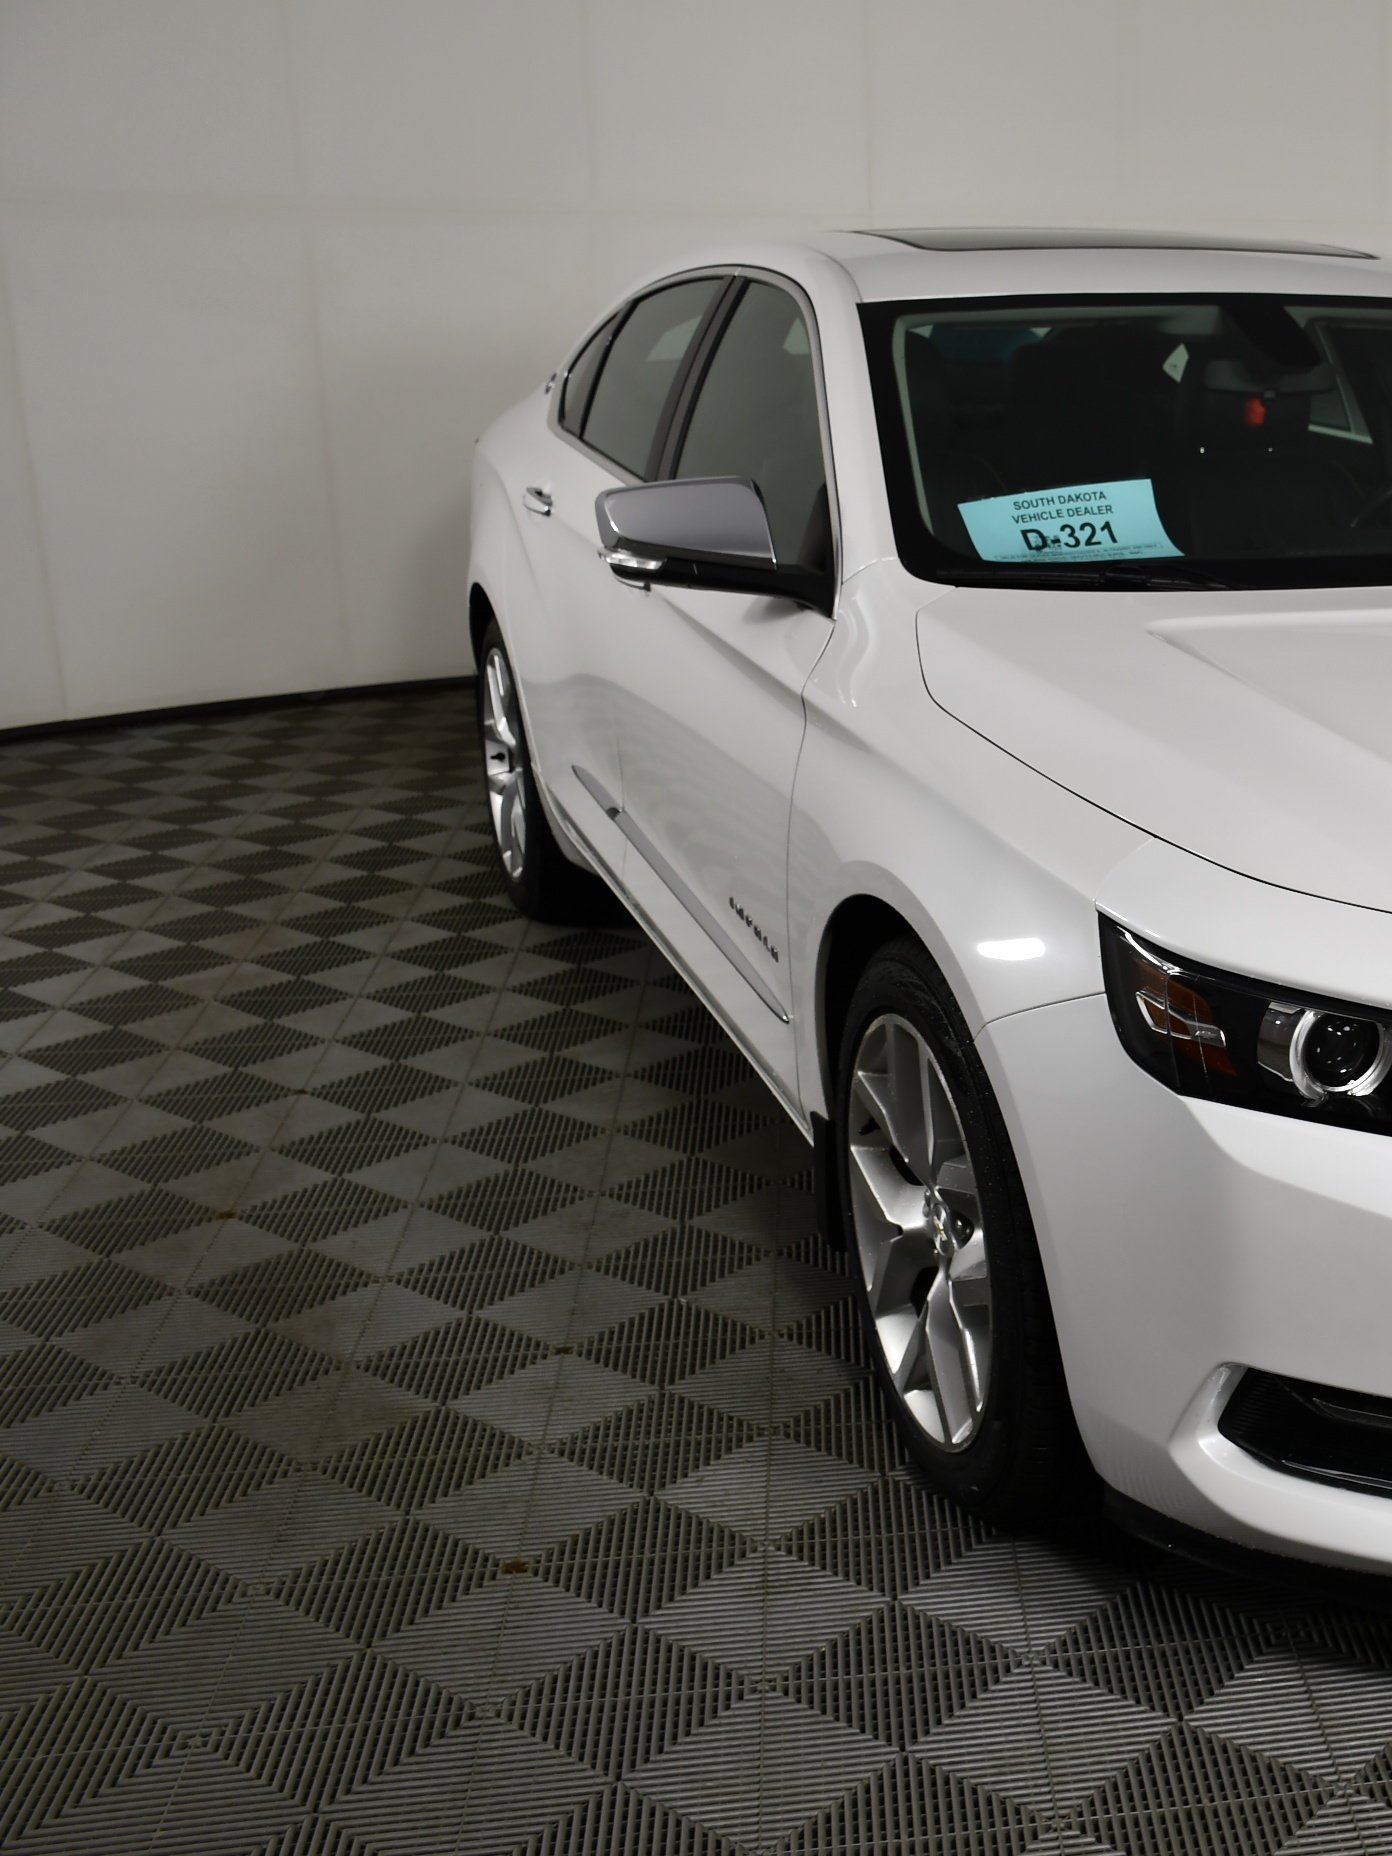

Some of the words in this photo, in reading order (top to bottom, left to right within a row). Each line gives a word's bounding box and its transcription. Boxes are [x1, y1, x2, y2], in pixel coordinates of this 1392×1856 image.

[1013, 496, 1055, 511] SOUTH
[1058, 491, 1107, 505] DAKOTA
[1012, 508, 1064, 524] VEHICLE
[1067, 504, 1114, 517] DEALER
[1020, 521, 1118, 552] D-321
